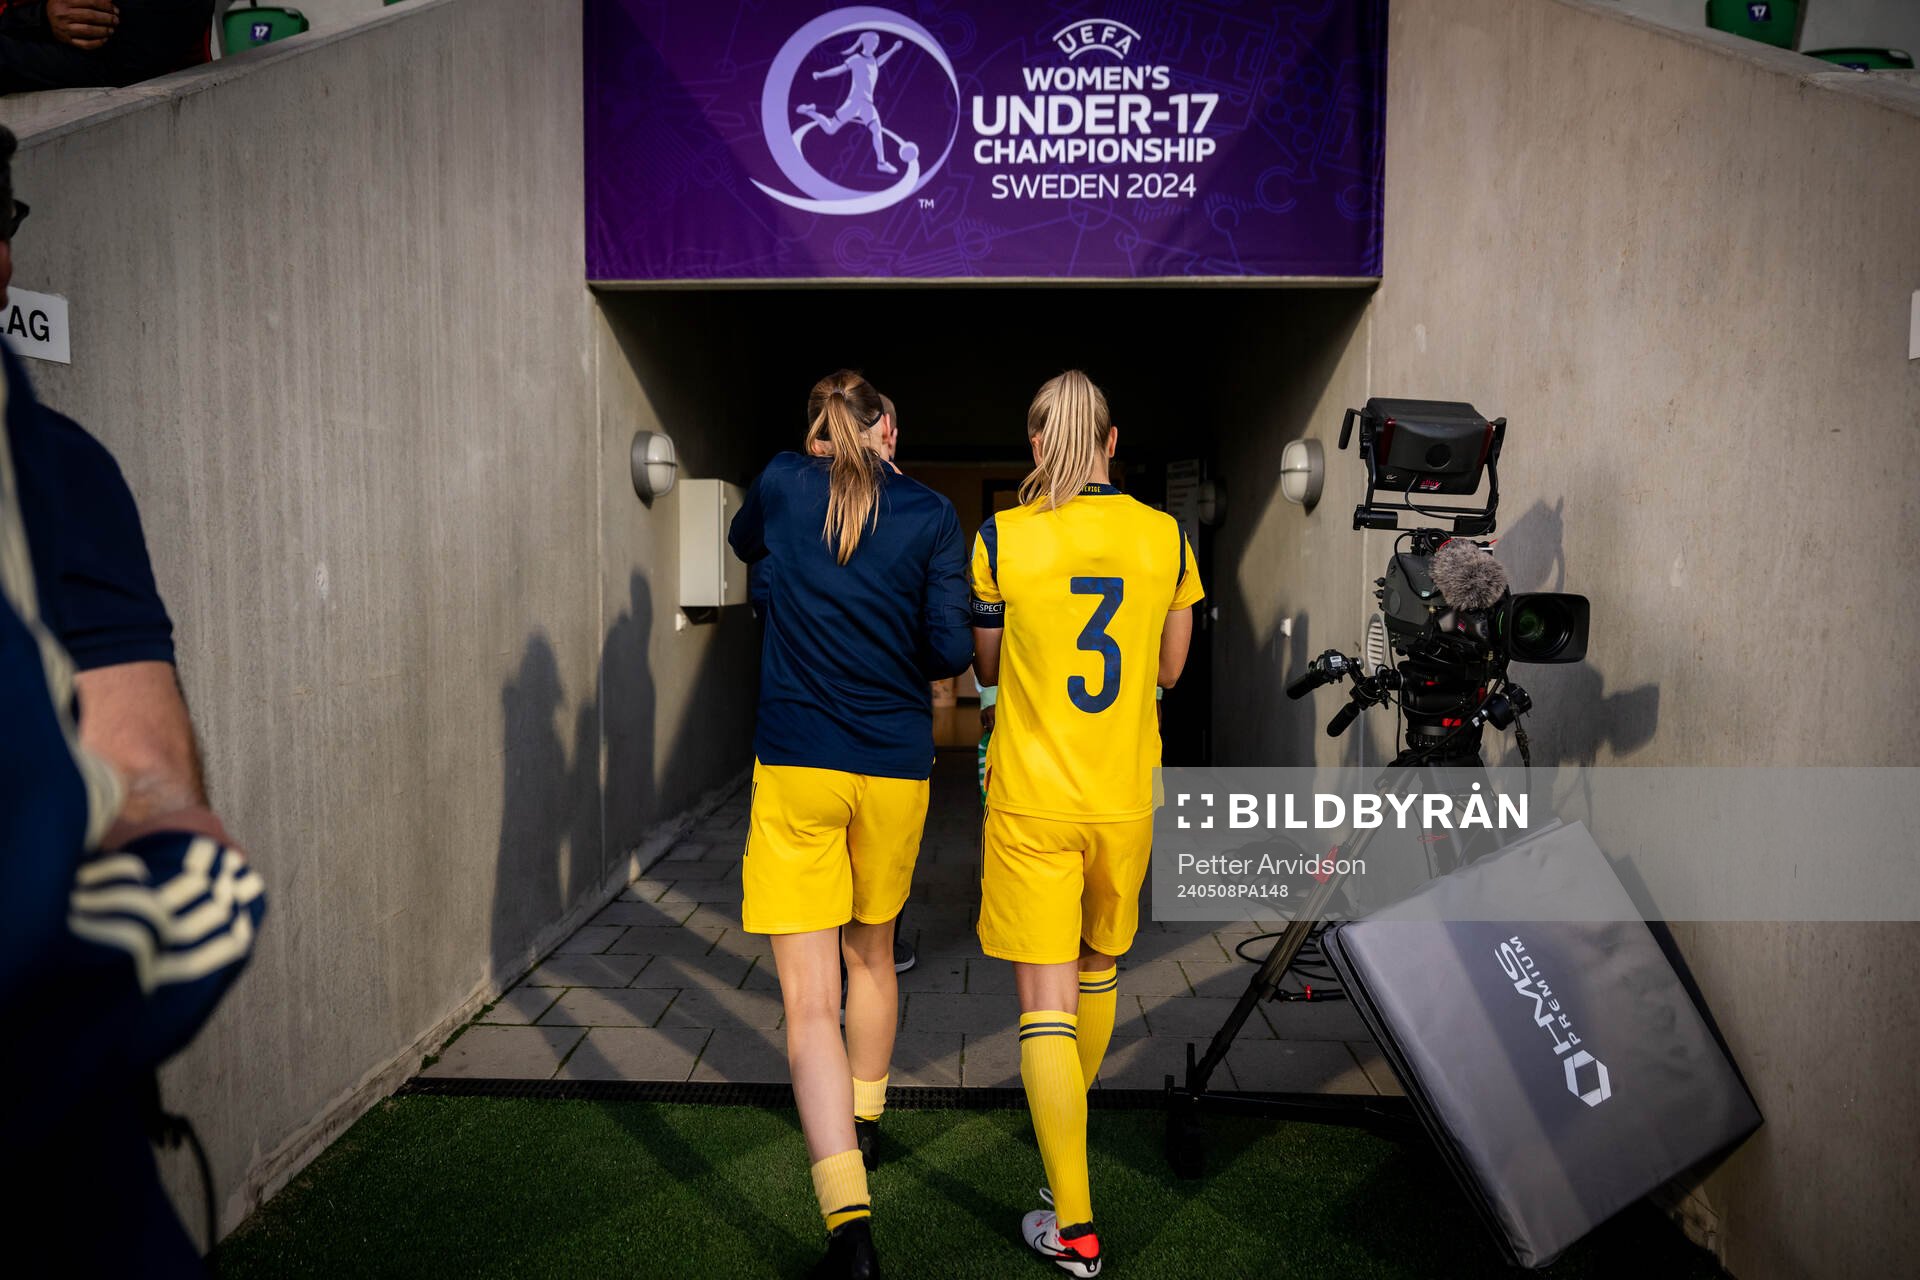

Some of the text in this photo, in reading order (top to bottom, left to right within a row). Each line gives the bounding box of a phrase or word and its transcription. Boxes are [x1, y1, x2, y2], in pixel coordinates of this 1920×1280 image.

[1751, 5, 1767, 18] 17
[254, 25, 269, 38] 17
[1057, 25, 1133, 55] UEFA
[1022, 66, 1170, 91] WOMEN'S
[972, 94, 1219, 135] UNDER-17
[973, 138, 1216, 164] CHAMPIONSHIP
[991, 173, 1197, 199] SWEDEN 2024
[0, 305, 50, 343] AG
[1067, 577, 1124, 713] 3
[1494, 942, 1571, 1055] HMS
[1509, 936, 1582, 1045] PREMIUM
